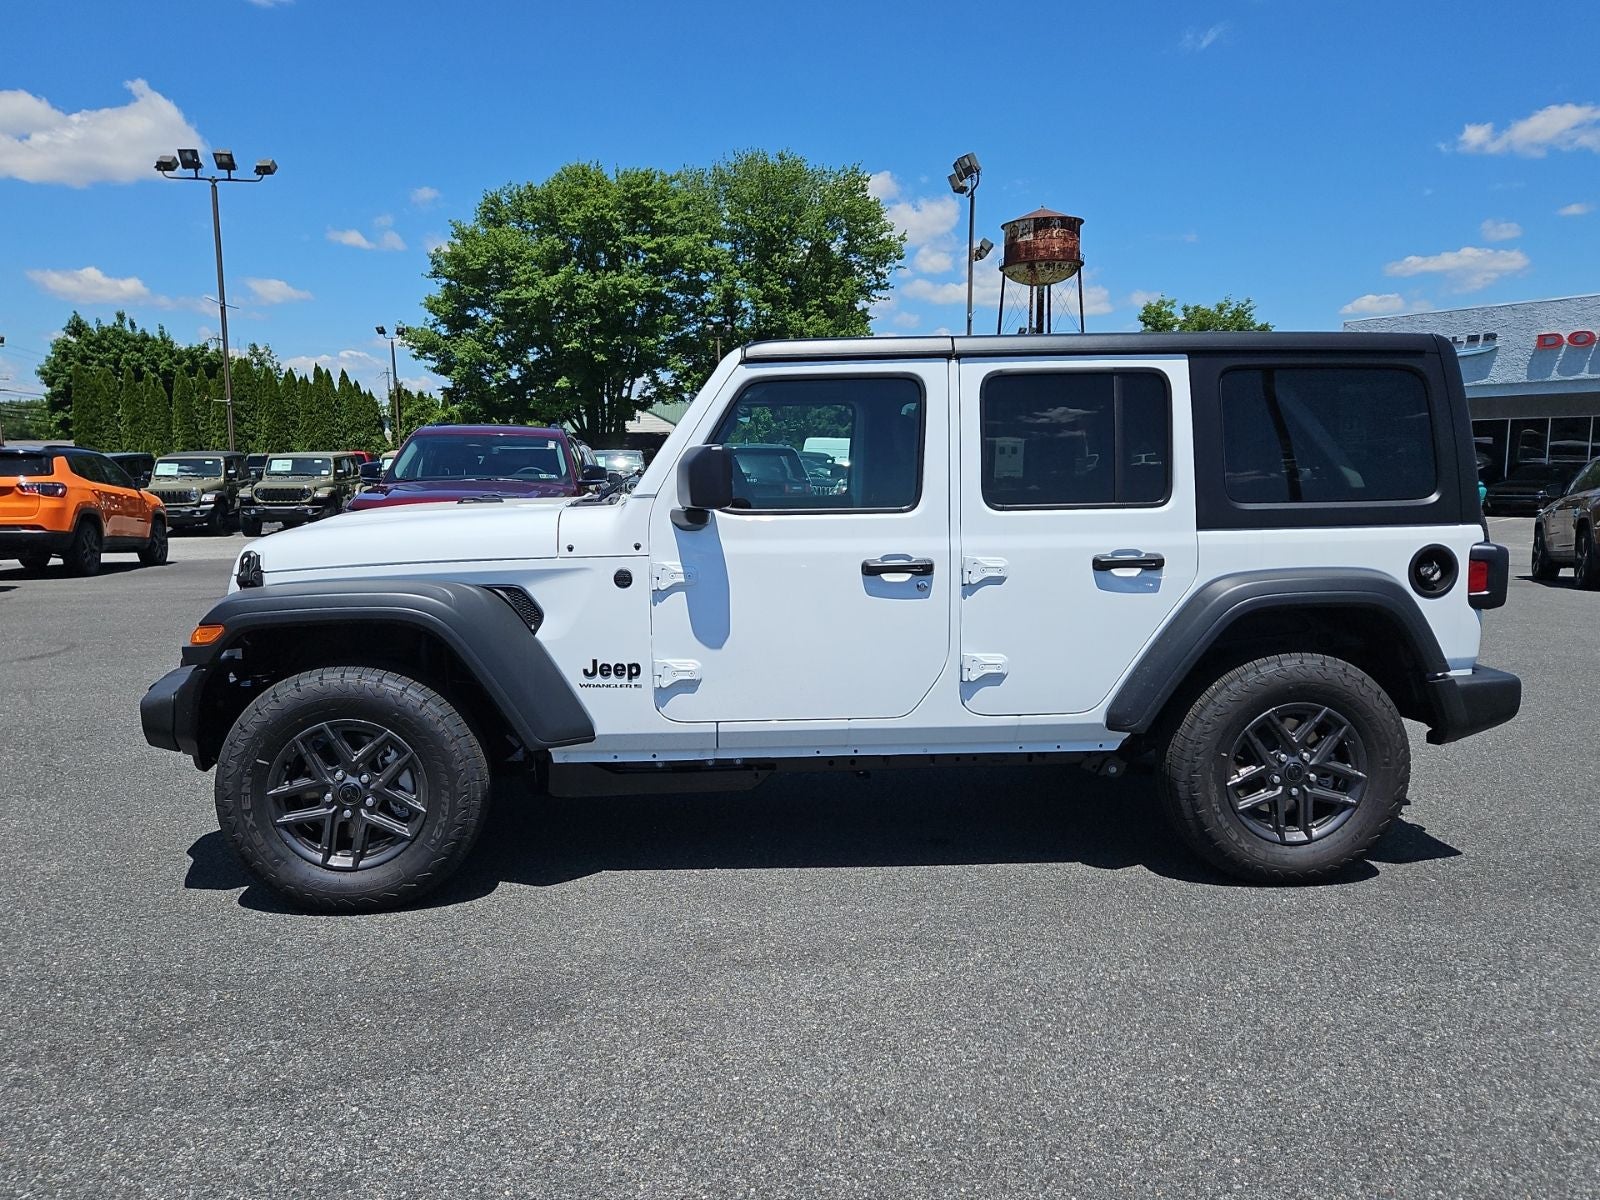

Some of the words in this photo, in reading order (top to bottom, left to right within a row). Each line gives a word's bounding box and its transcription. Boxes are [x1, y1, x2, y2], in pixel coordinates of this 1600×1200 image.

[1451, 332, 1498, 344] LER
[1536, 330, 1600, 350] DO
[583, 658, 641, 681] Jeep
